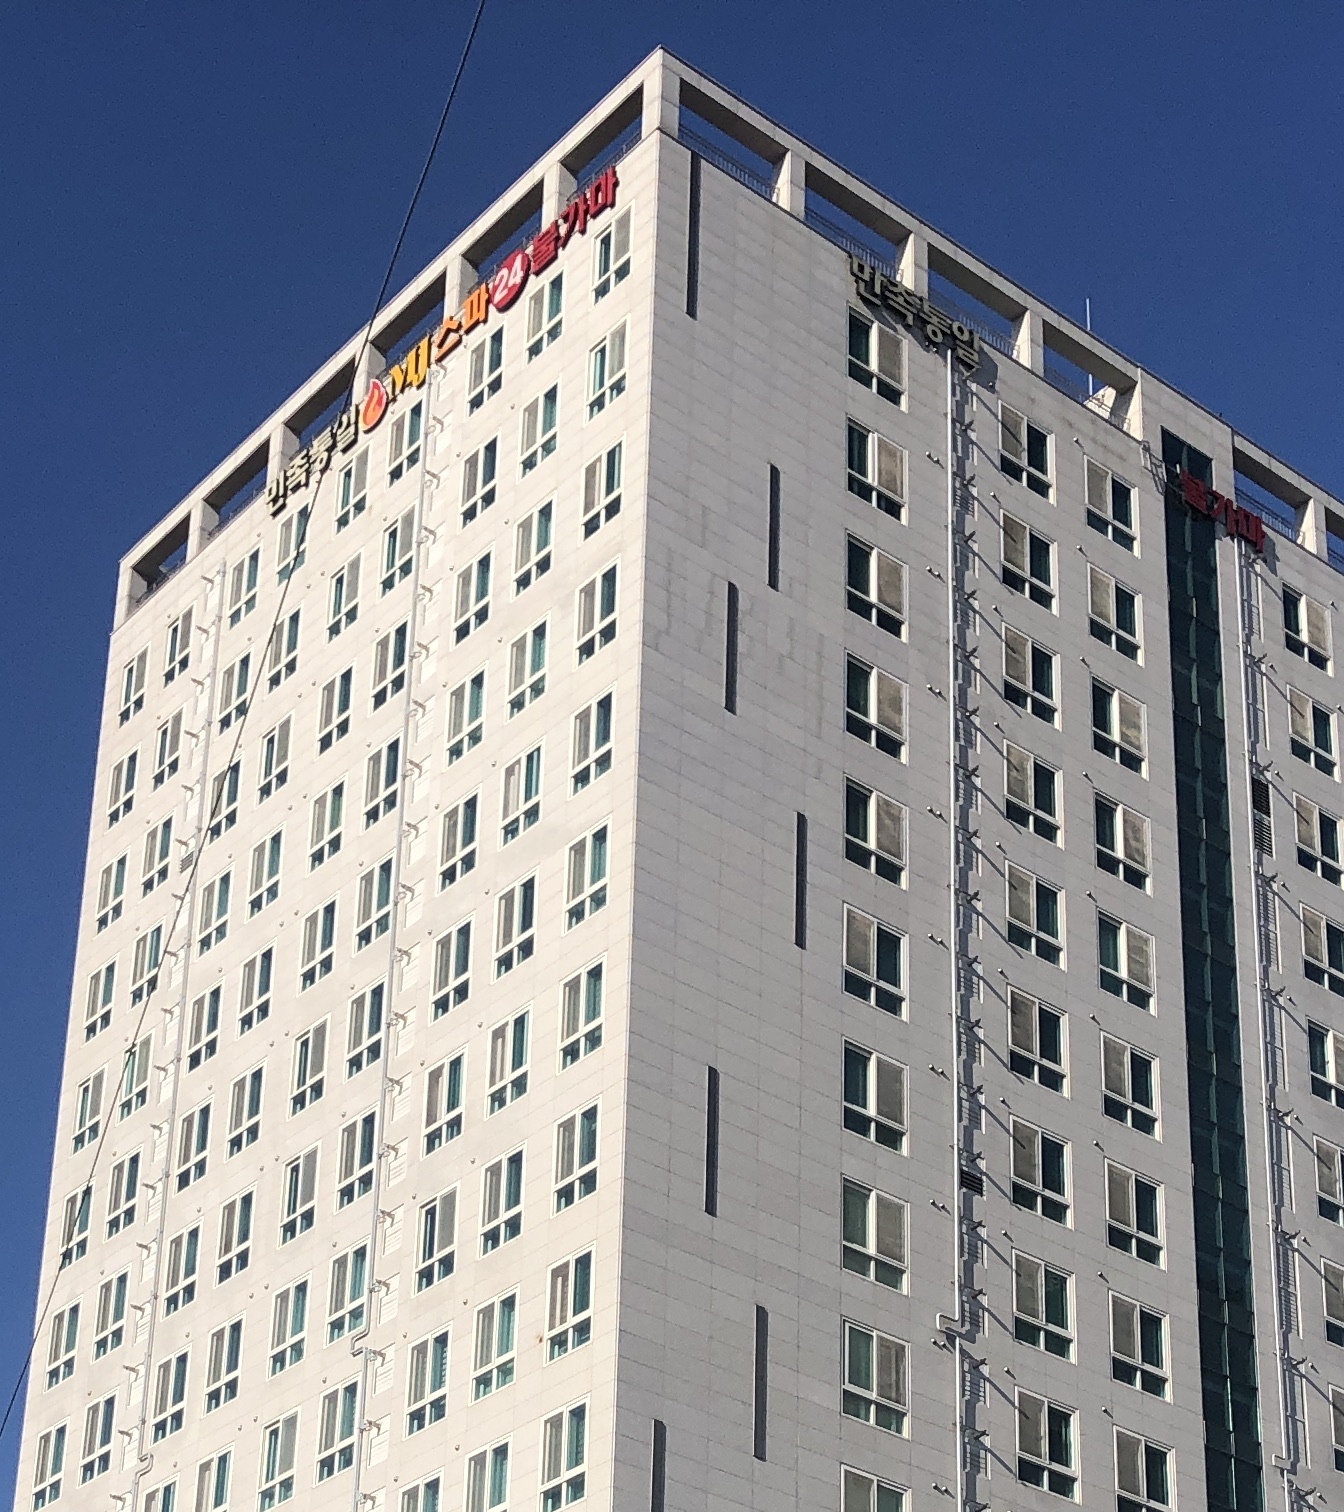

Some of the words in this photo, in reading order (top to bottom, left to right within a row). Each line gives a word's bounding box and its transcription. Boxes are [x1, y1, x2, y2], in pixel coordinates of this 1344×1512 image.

[435, 284, 489, 361] 스파
[492, 253, 523, 305] 24
[531, 165, 618, 275] 불가마
[851, 255, 980, 368] 민족통일
